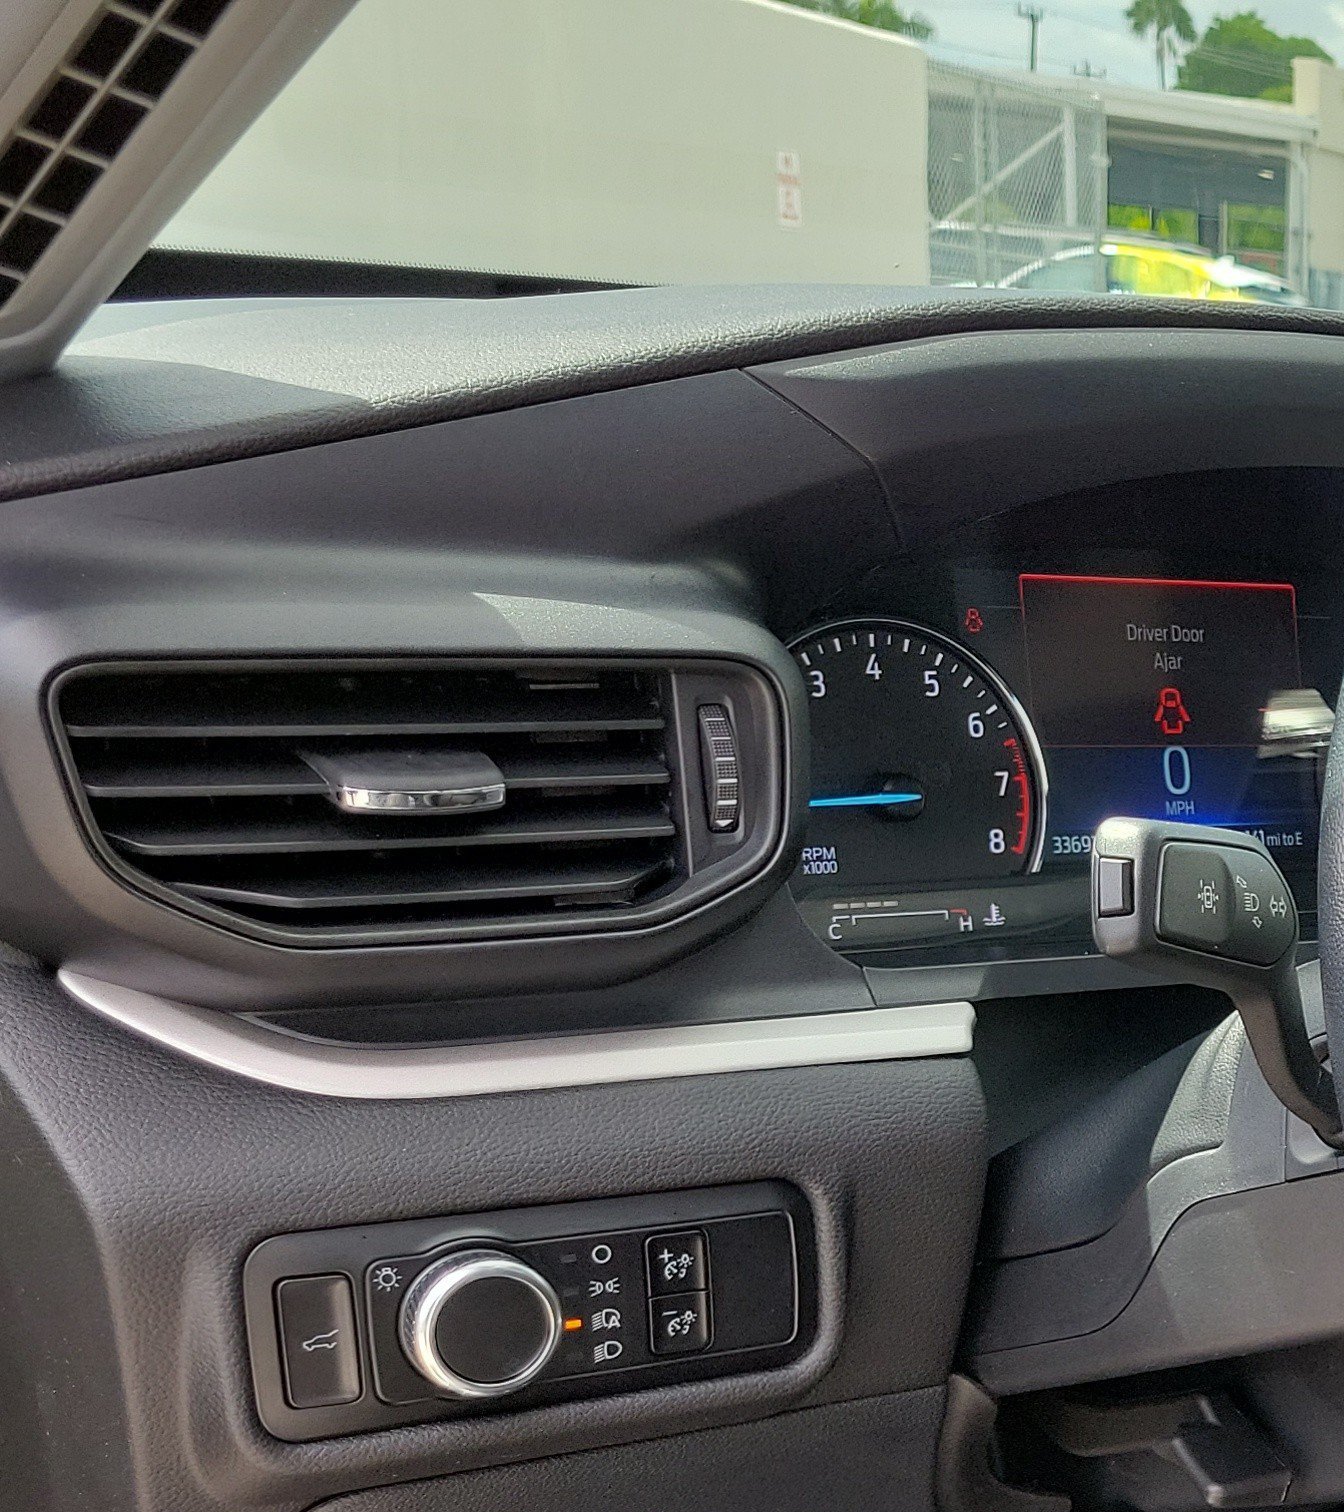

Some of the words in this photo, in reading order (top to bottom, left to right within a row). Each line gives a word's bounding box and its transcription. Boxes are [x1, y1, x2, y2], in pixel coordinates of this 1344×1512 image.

[1126, 624, 1168, 642] Driver
[1171, 625, 1205, 642] Door
[866, 653, 882, 680] 4
[1154, 653, 1182, 672] Ajar
[811, 671, 826, 697] 3
[923, 671, 940, 697] 5
[967, 712, 984, 738] 6
[1162, 745, 1191, 795] 0
[994, 771, 1009, 797] 7
[1165, 801, 1195, 816] MPH
[989, 828, 1005, 854] 8
[1266, 832, 1281, 847] mi
[1282, 832, 1294, 847] to
[1295, 831, 1304, 846] E
[801, 847, 836, 861] RPM
[802, 861, 838, 875] x1000
[828, 924, 843, 941] C
[958, 915, 973, 933] H
